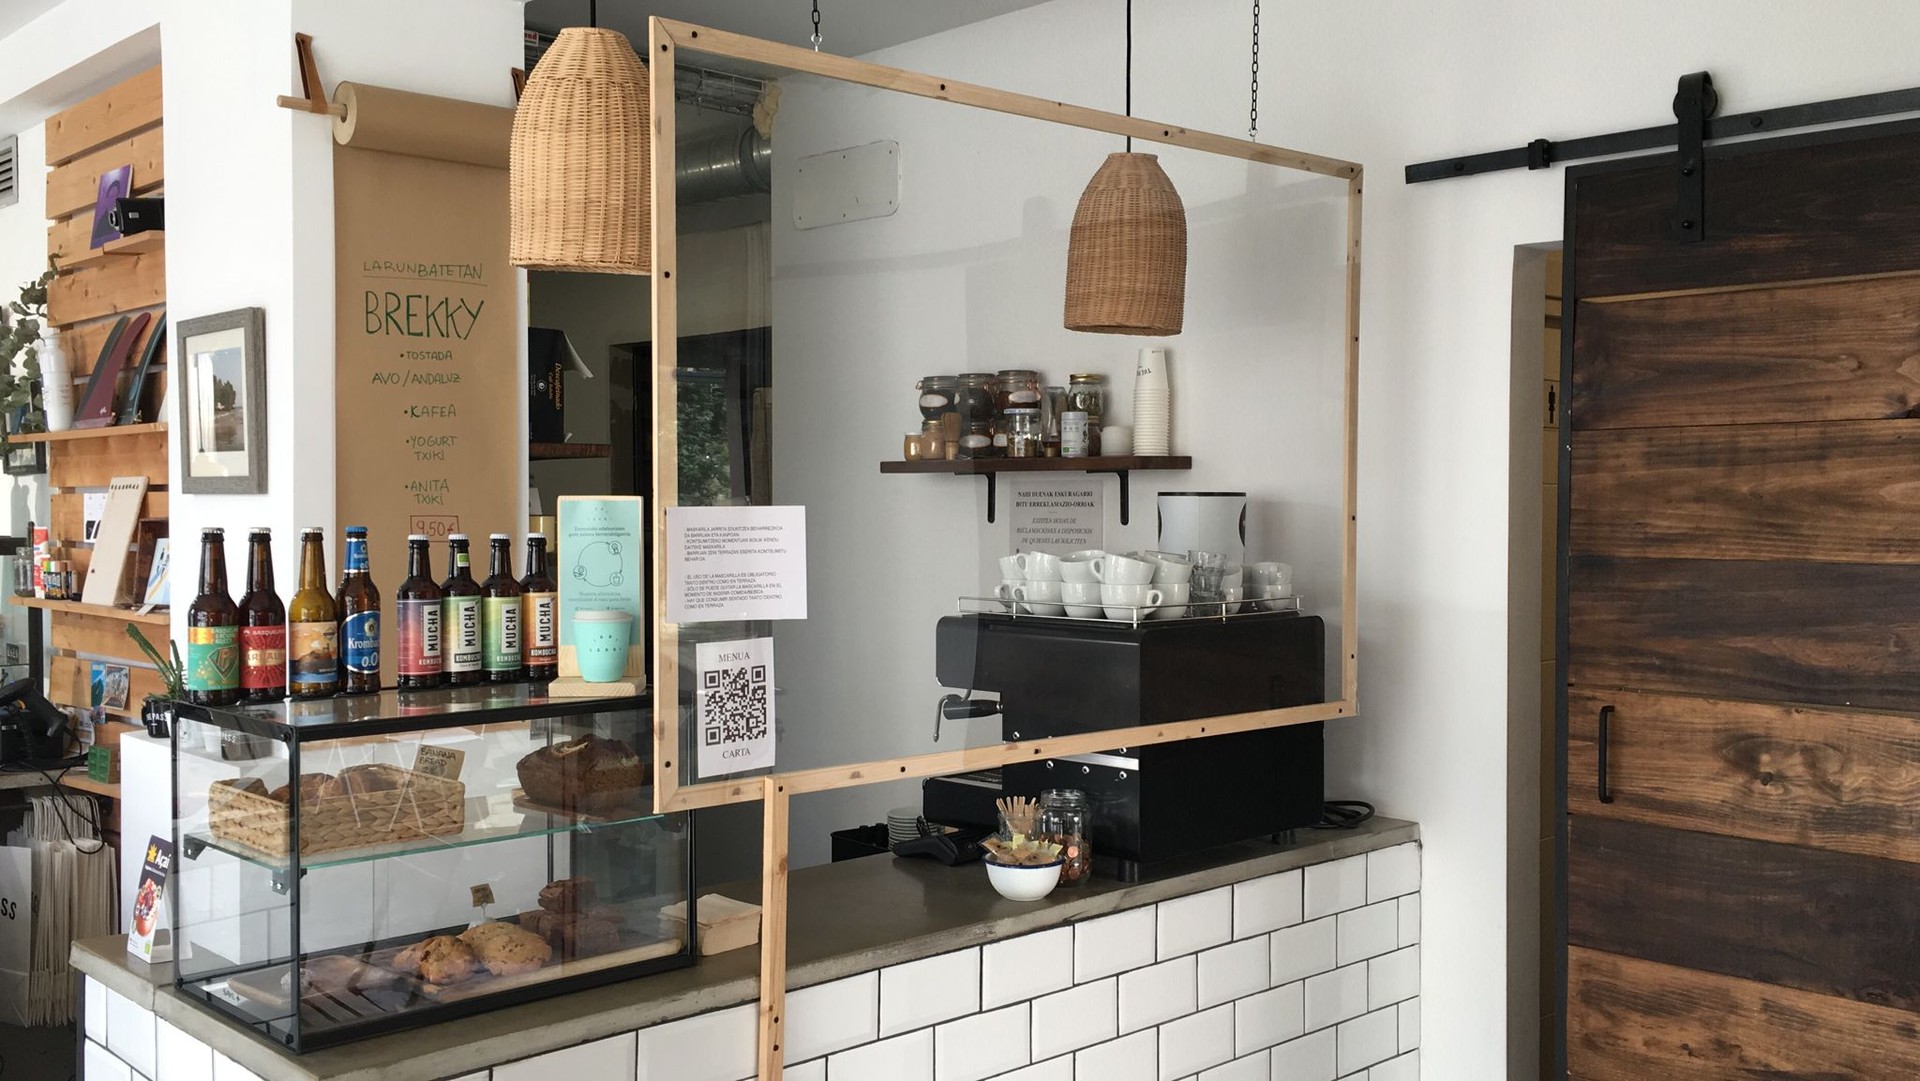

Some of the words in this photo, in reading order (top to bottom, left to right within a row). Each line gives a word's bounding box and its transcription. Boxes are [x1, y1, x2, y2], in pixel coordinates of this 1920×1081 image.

[363, 260, 482, 280] LARUNBATETAN
[365, 290, 484, 340] BREKKY
[406, 350, 453, 361] TOSTADA
[410, 404, 457, 418] KAFEA
[410, 435, 458, 448] YOGURT
[414, 450, 445, 461] TXIKI
[410, 479, 450, 492] ANITA
[414, 493, 444, 505] TXIKI
[464, 605, 476, 647] MUCHA
[540, 601, 551, 642] MUCHA
[427, 609, 438, 652] MUCHA
[505, 608, 517, 649] MUCHA
[718, 652, 751, 663] MENUA
[722, 747, 751, 759] CARTA
